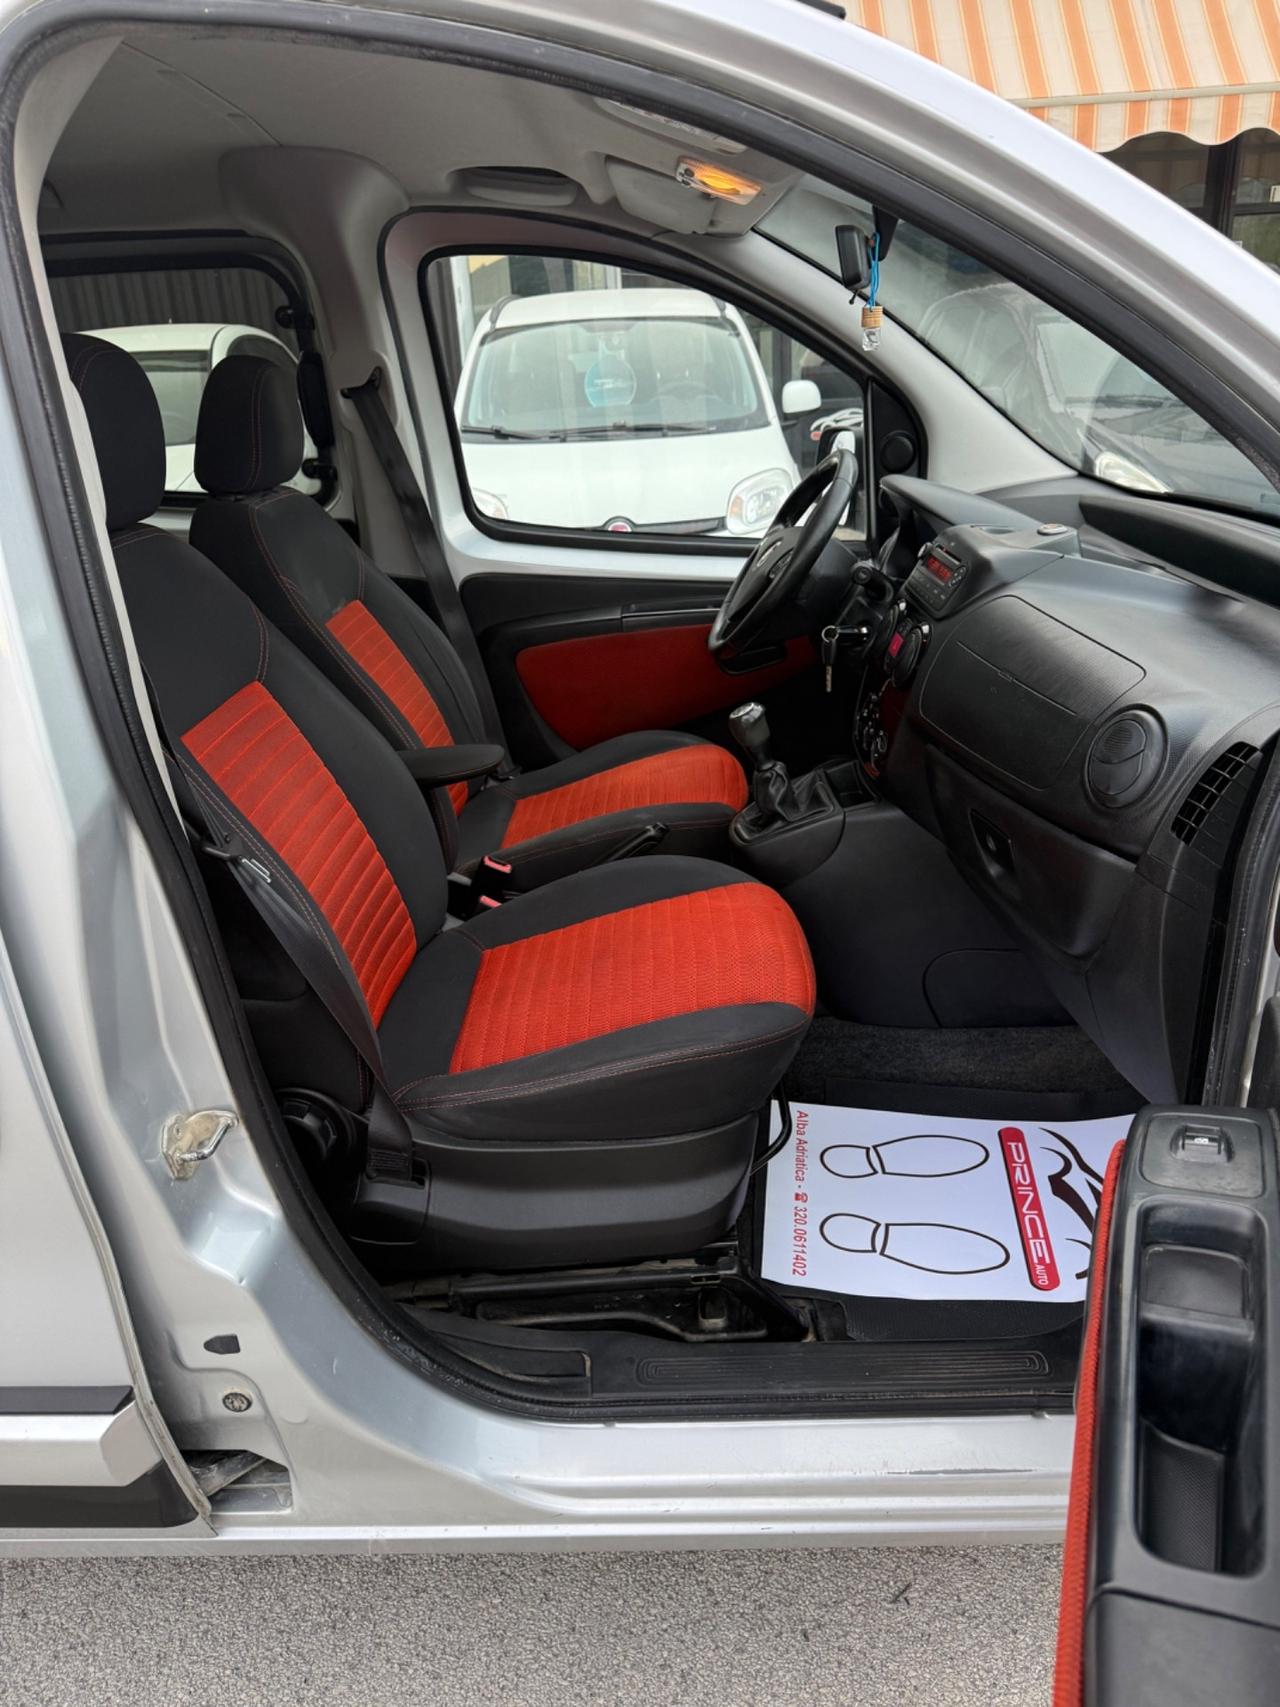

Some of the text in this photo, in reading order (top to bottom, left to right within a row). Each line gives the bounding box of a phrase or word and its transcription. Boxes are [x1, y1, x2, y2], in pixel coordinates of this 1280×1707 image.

[796, 1110, 809, 1136] Alba
[795, 1138, 808, 1182] Adriatica
[792, 1206, 808, 1277] 320.0611402
[1007, 1141, 1051, 1286] PRINCE AUTO
